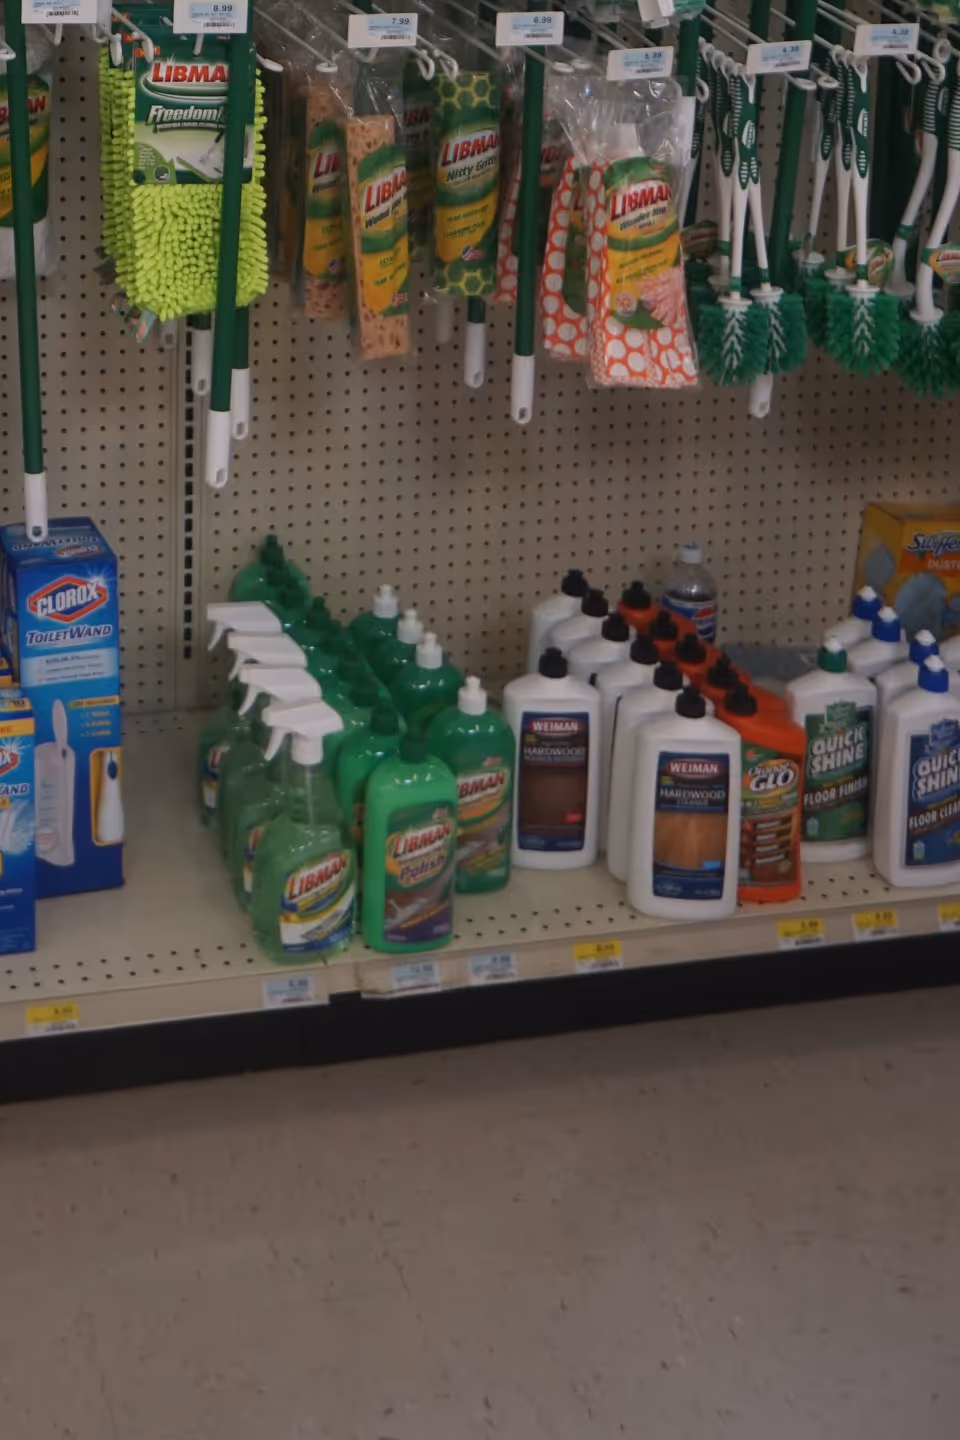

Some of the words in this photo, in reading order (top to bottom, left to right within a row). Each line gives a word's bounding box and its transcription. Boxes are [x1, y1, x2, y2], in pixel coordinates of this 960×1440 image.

[213, 4, 233, 12] 8.99
[391, 18, 410, 26] 7.99
[152, 62, 228, 82] LIBMA
[36, 583, 99, 617] CLOROX
[532, 720, 579, 732] WEIMAN
[812, 727, 864, 754] QUICK
[523, 746, 586, 757] HARDWOOD
[811, 744, 864, 773] SHINE
[670, 762, 719, 774] WEIMAN
[751, 768, 794, 793] GLO
[660, 788, 725, 800] HARDWOOD
[804, 787, 835, 806] FLOOR
[909, 809, 936, 829] FLOOR
[393, 823, 452, 858] LIBMAN
[400, 854, 446, 881] Polish
[287, 854, 347, 902] LIBMAN
